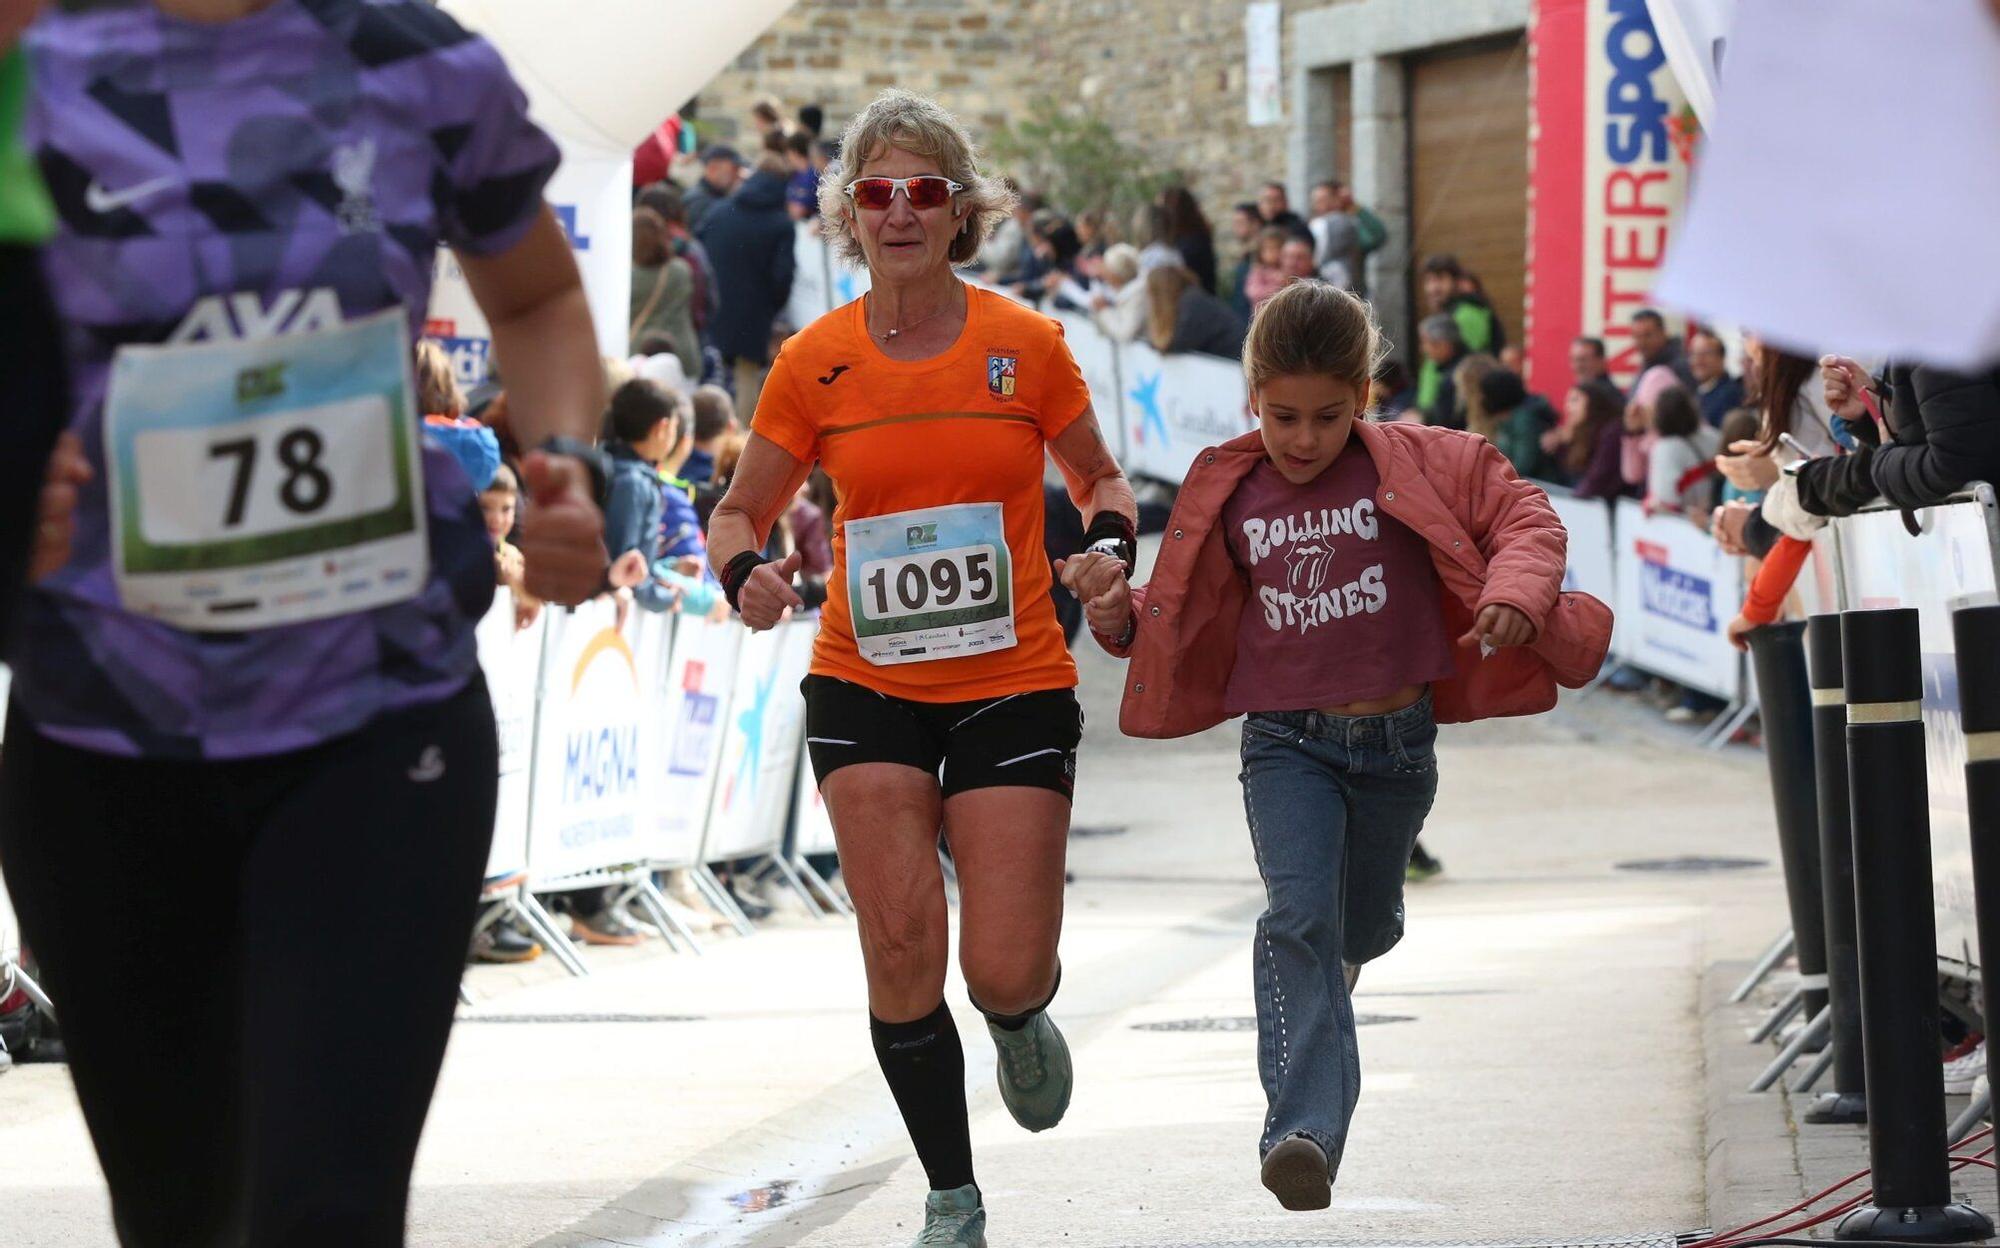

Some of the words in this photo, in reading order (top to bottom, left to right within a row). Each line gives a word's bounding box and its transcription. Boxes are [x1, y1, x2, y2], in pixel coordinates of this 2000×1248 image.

[207, 423, 335, 529] 78
[1243, 498, 1379, 566] ROLLING
[867, 552, 993, 614] 1095
[562, 724, 639, 804] MAGNA
